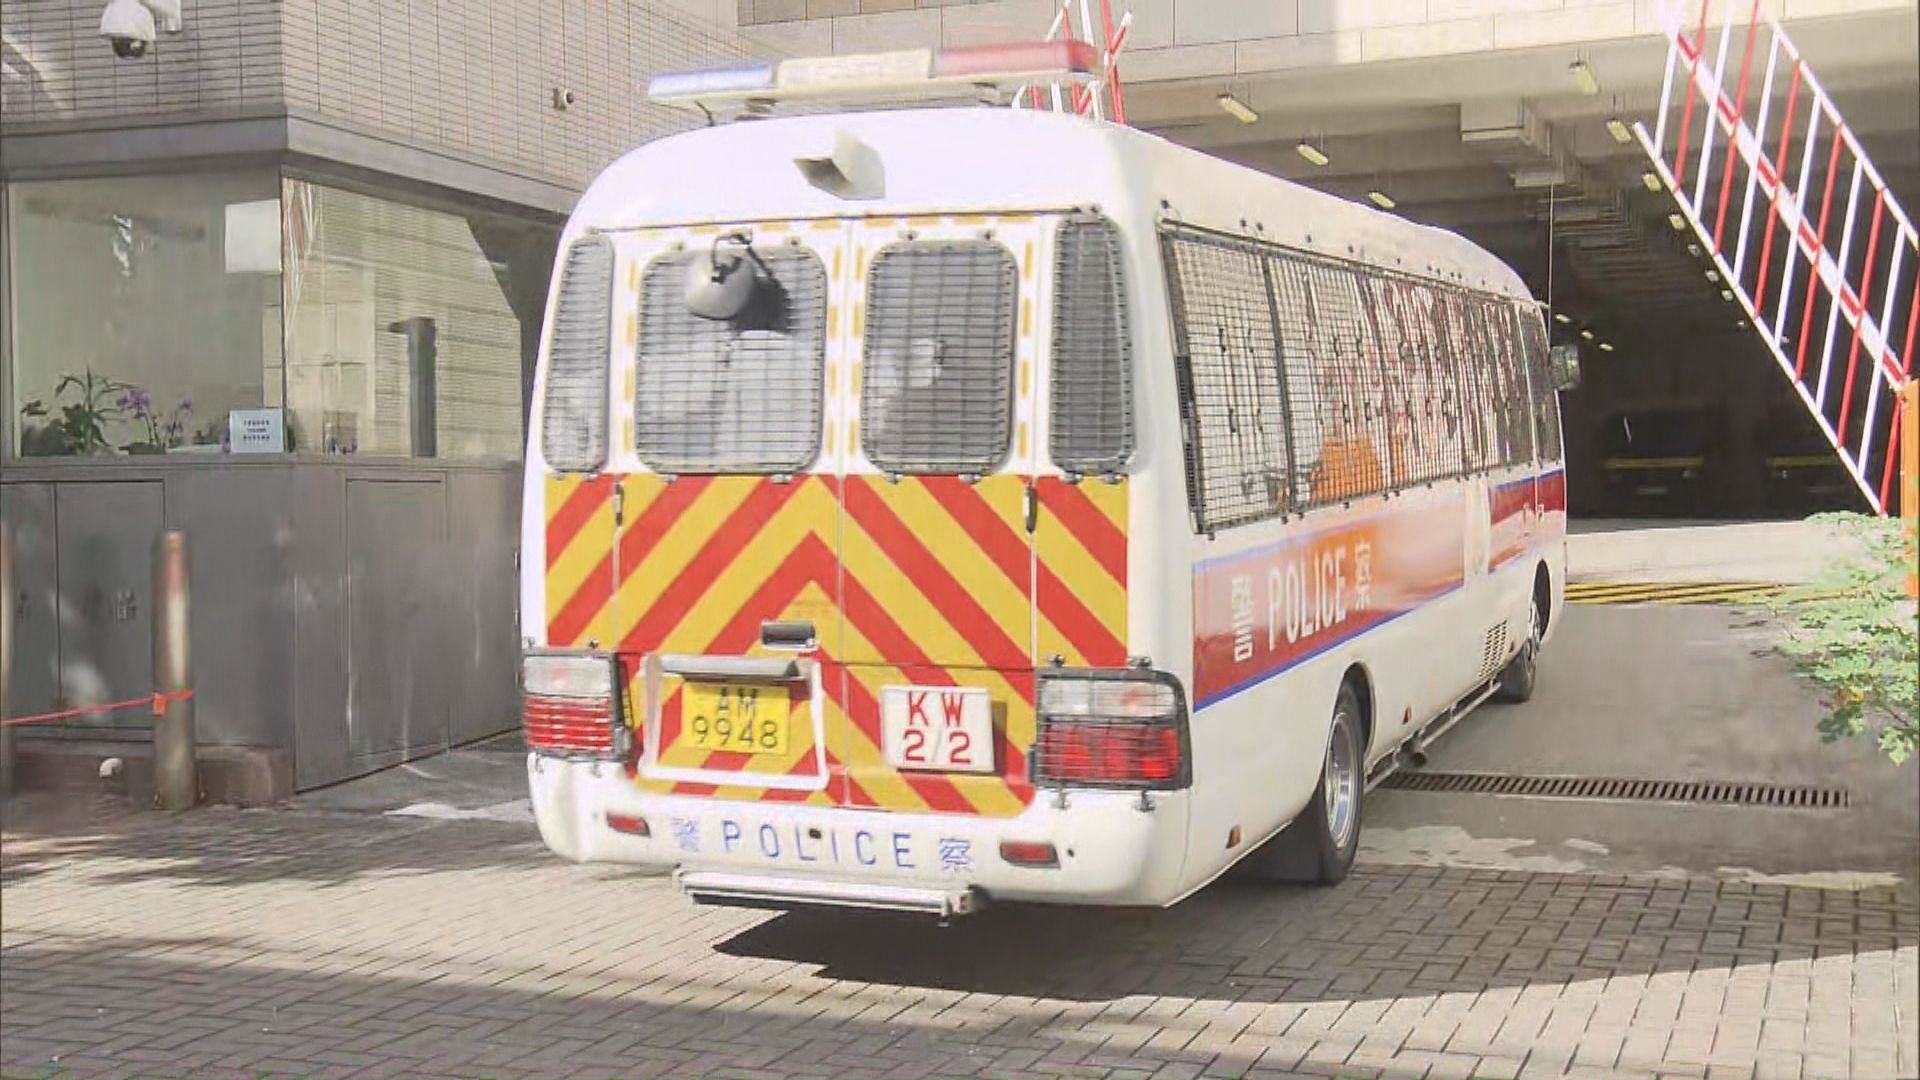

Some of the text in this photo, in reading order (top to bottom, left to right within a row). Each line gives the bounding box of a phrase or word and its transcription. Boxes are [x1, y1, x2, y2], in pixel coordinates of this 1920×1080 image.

[1268, 548, 1346, 652] POLICE
[716, 687, 757, 717] AM
[692, 716, 778, 748] 9948
[722, 820, 916, 868] POLICE
